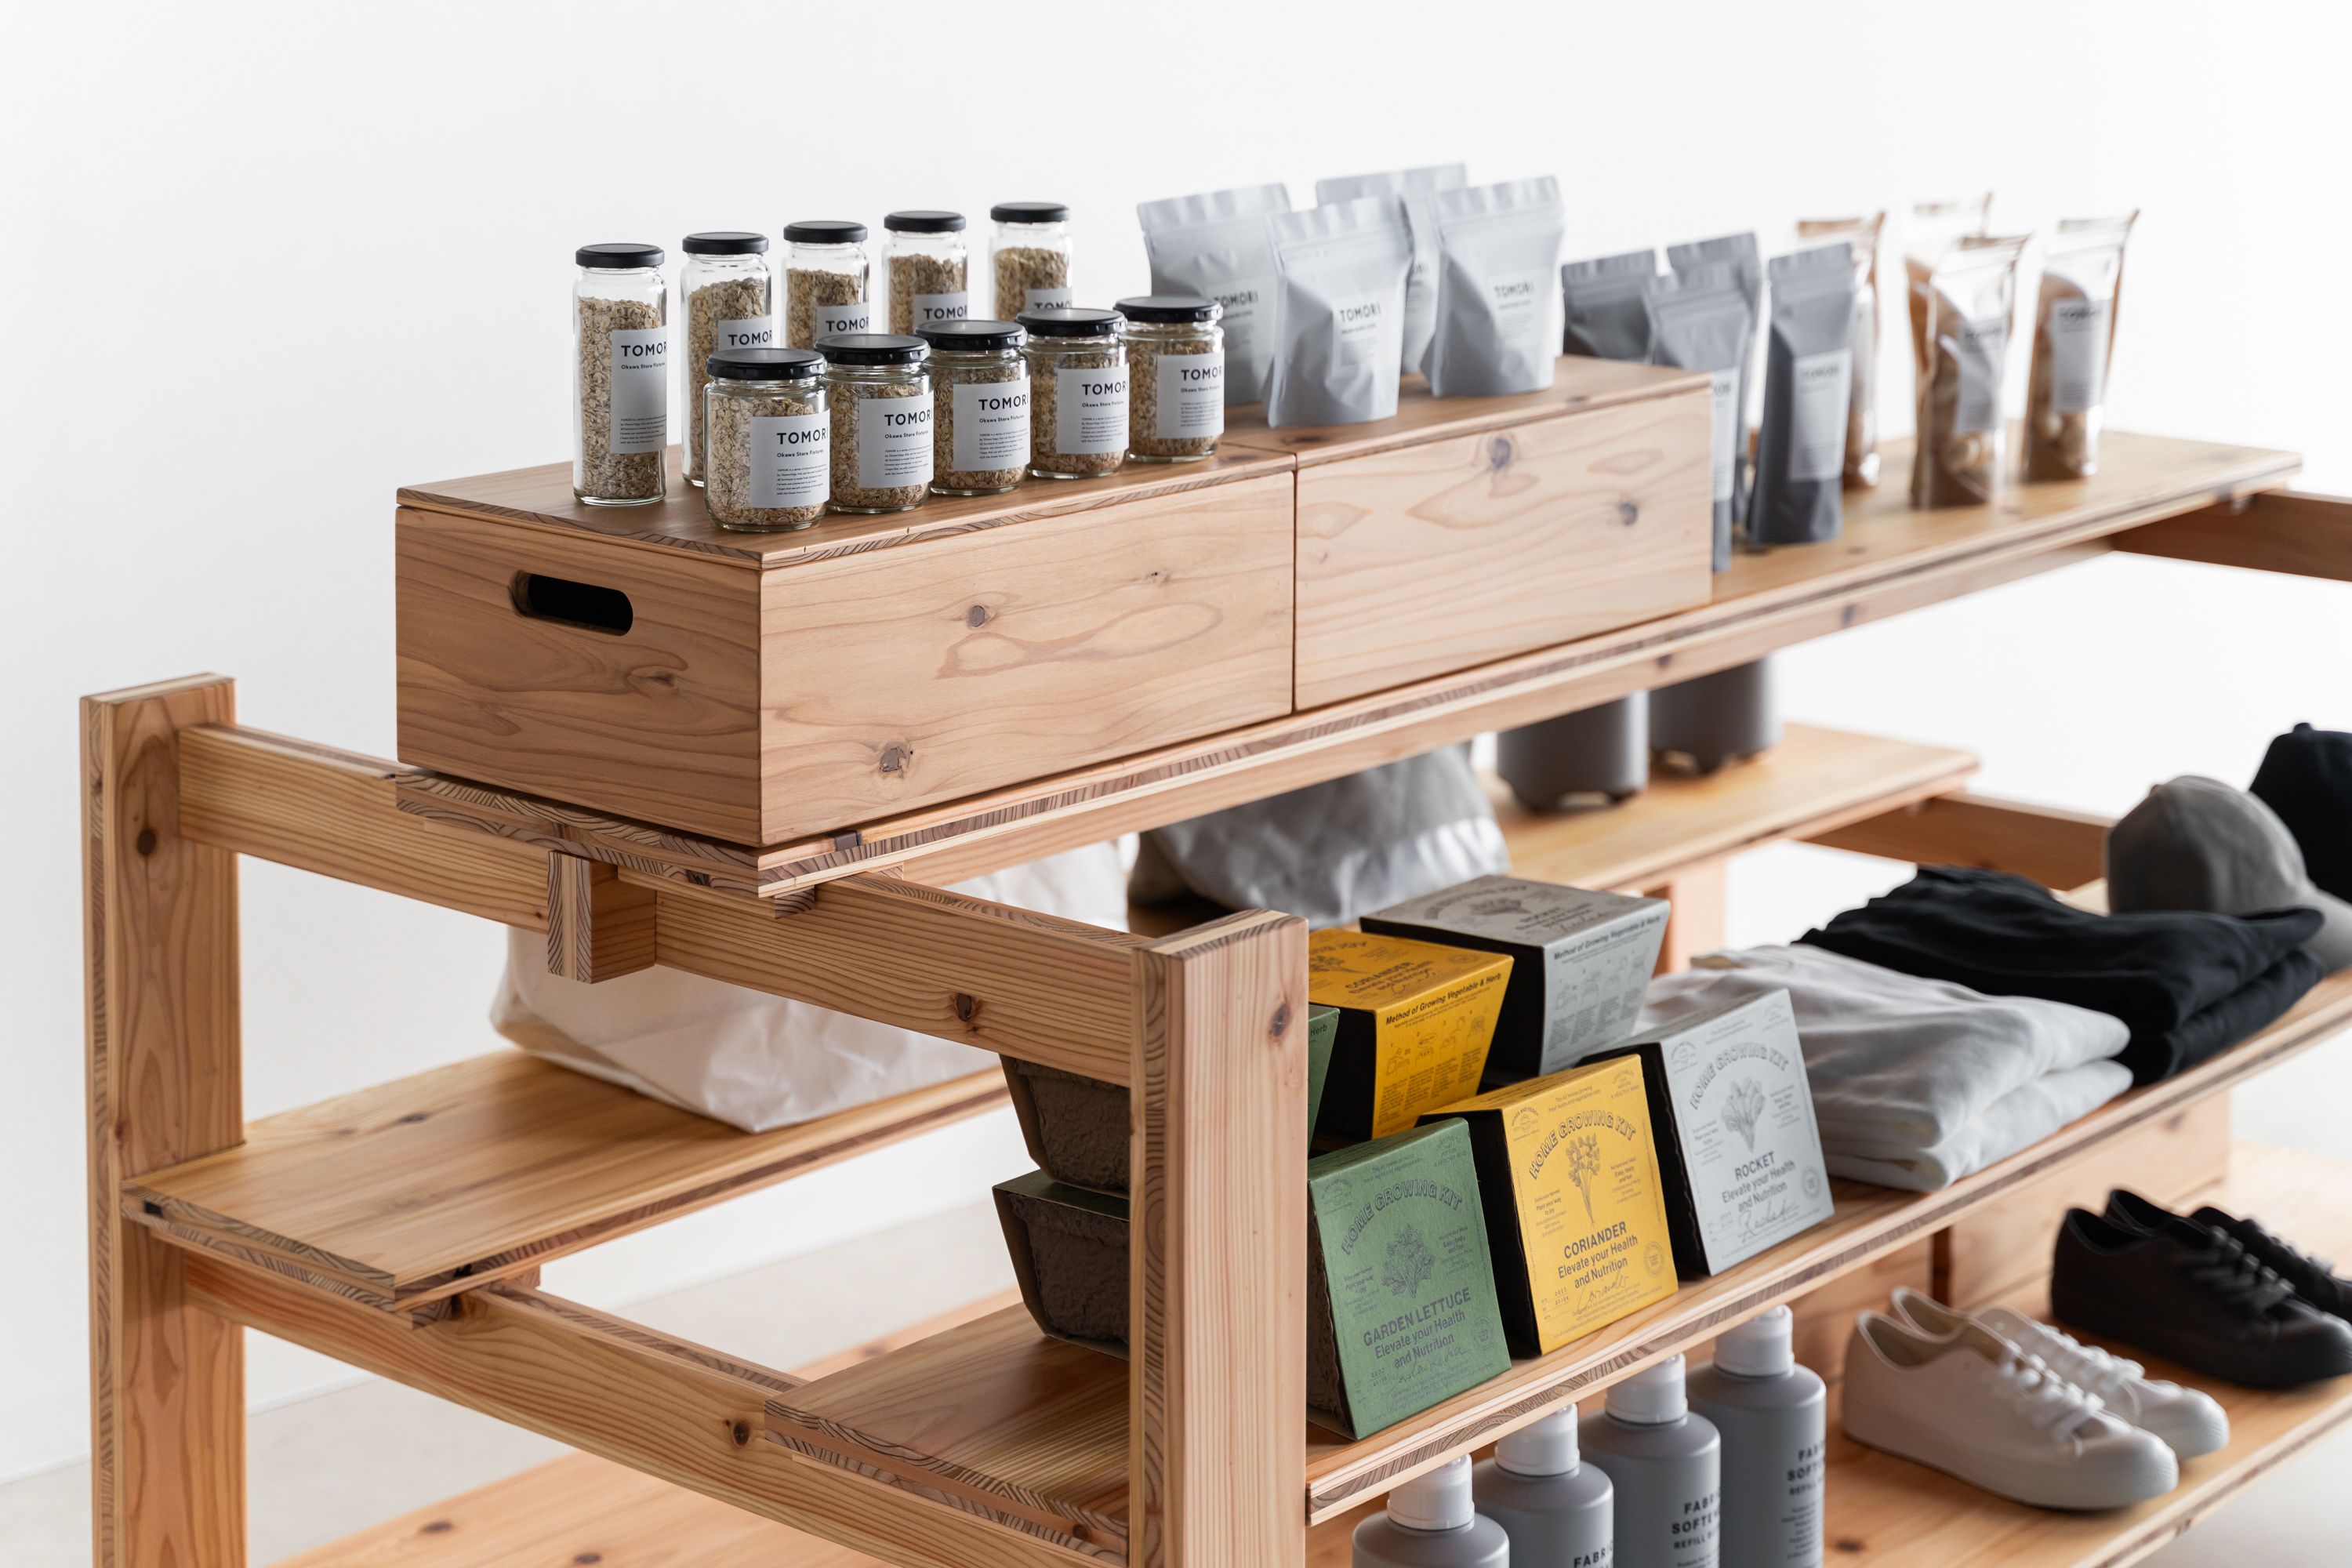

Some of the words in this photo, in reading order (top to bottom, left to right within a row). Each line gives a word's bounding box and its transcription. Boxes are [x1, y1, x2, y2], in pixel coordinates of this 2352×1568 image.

[1494, 280, 1535, 298] TOMORI
[826, 316, 869, 332] TOMOR
[1340, 302, 1381, 322] TOMORI
[621, 341, 666, 358] TOMOR
[728, 329, 772, 347] TOMOR
[884, 408, 933, 426] TOMORI
[978, 392, 1029, 411] TOMORI
[776, 426, 829, 445] TOMORI
[1554, 946, 1577, 962] Method
[1584, 934, 1610, 949] Growing
[1345, 962, 1414, 989] CORIANDER
[1385, 1008, 1410, 1025] Method
[1411, 1005, 1419, 1015] of
[1419, 995, 1446, 1011] Growing
[1447, 982, 1479, 1000] Vegetable
[1479, 978, 1485, 987] &
[1486, 972, 1502, 984] Herb
[1310, 1023, 1328, 1036] Herb
[1689, 1062, 1717, 1110] HOME
[1715, 1041, 1768, 1071] GROWING
[1769, 1047, 1790, 1072] KIT
[1529, 1130, 1559, 1181] HOME
[1558, 1109, 1614, 1139] GROWING
[1615, 1115, 1637, 1142] KIT
[1722, 1182, 1751, 1203] Elevate
[1751, 1174, 1769, 1192] your
[1769, 1159, 1797, 1180] Health
[1734, 1150, 1775, 1181] ROCKET
[1536, 1203, 1546, 1211] Plant
[1738, 1196, 1754, 1213] and
[1752, 1181, 1788, 1205] Nutrition
[1341, 1202, 1375, 1257] HOME
[1374, 1179, 1437, 1211] GROWING
[1439, 1185, 1463, 1211] KIT
[1558, 1257, 1590, 1279] Elevate
[1590, 1247, 1610, 1267] your
[1610, 1233, 1639, 1256] Health
[1563, 1221, 1628, 1260] CORIANDER
[1574, 1271, 1591, 1289] and
[1590, 1257, 1628, 1283] Nutrition
[1363, 1312, 1414, 1348] GARDEN
[1415, 1287, 1472, 1323] LETTUCE
[1374, 1333, 1412, 1359] Elevate
[1411, 1324, 1434, 1345] your
[1435, 1308, 1466, 1334] Health
[1394, 1350, 1413, 1370] and
[1412, 1333, 1455, 1359] Nutrition
